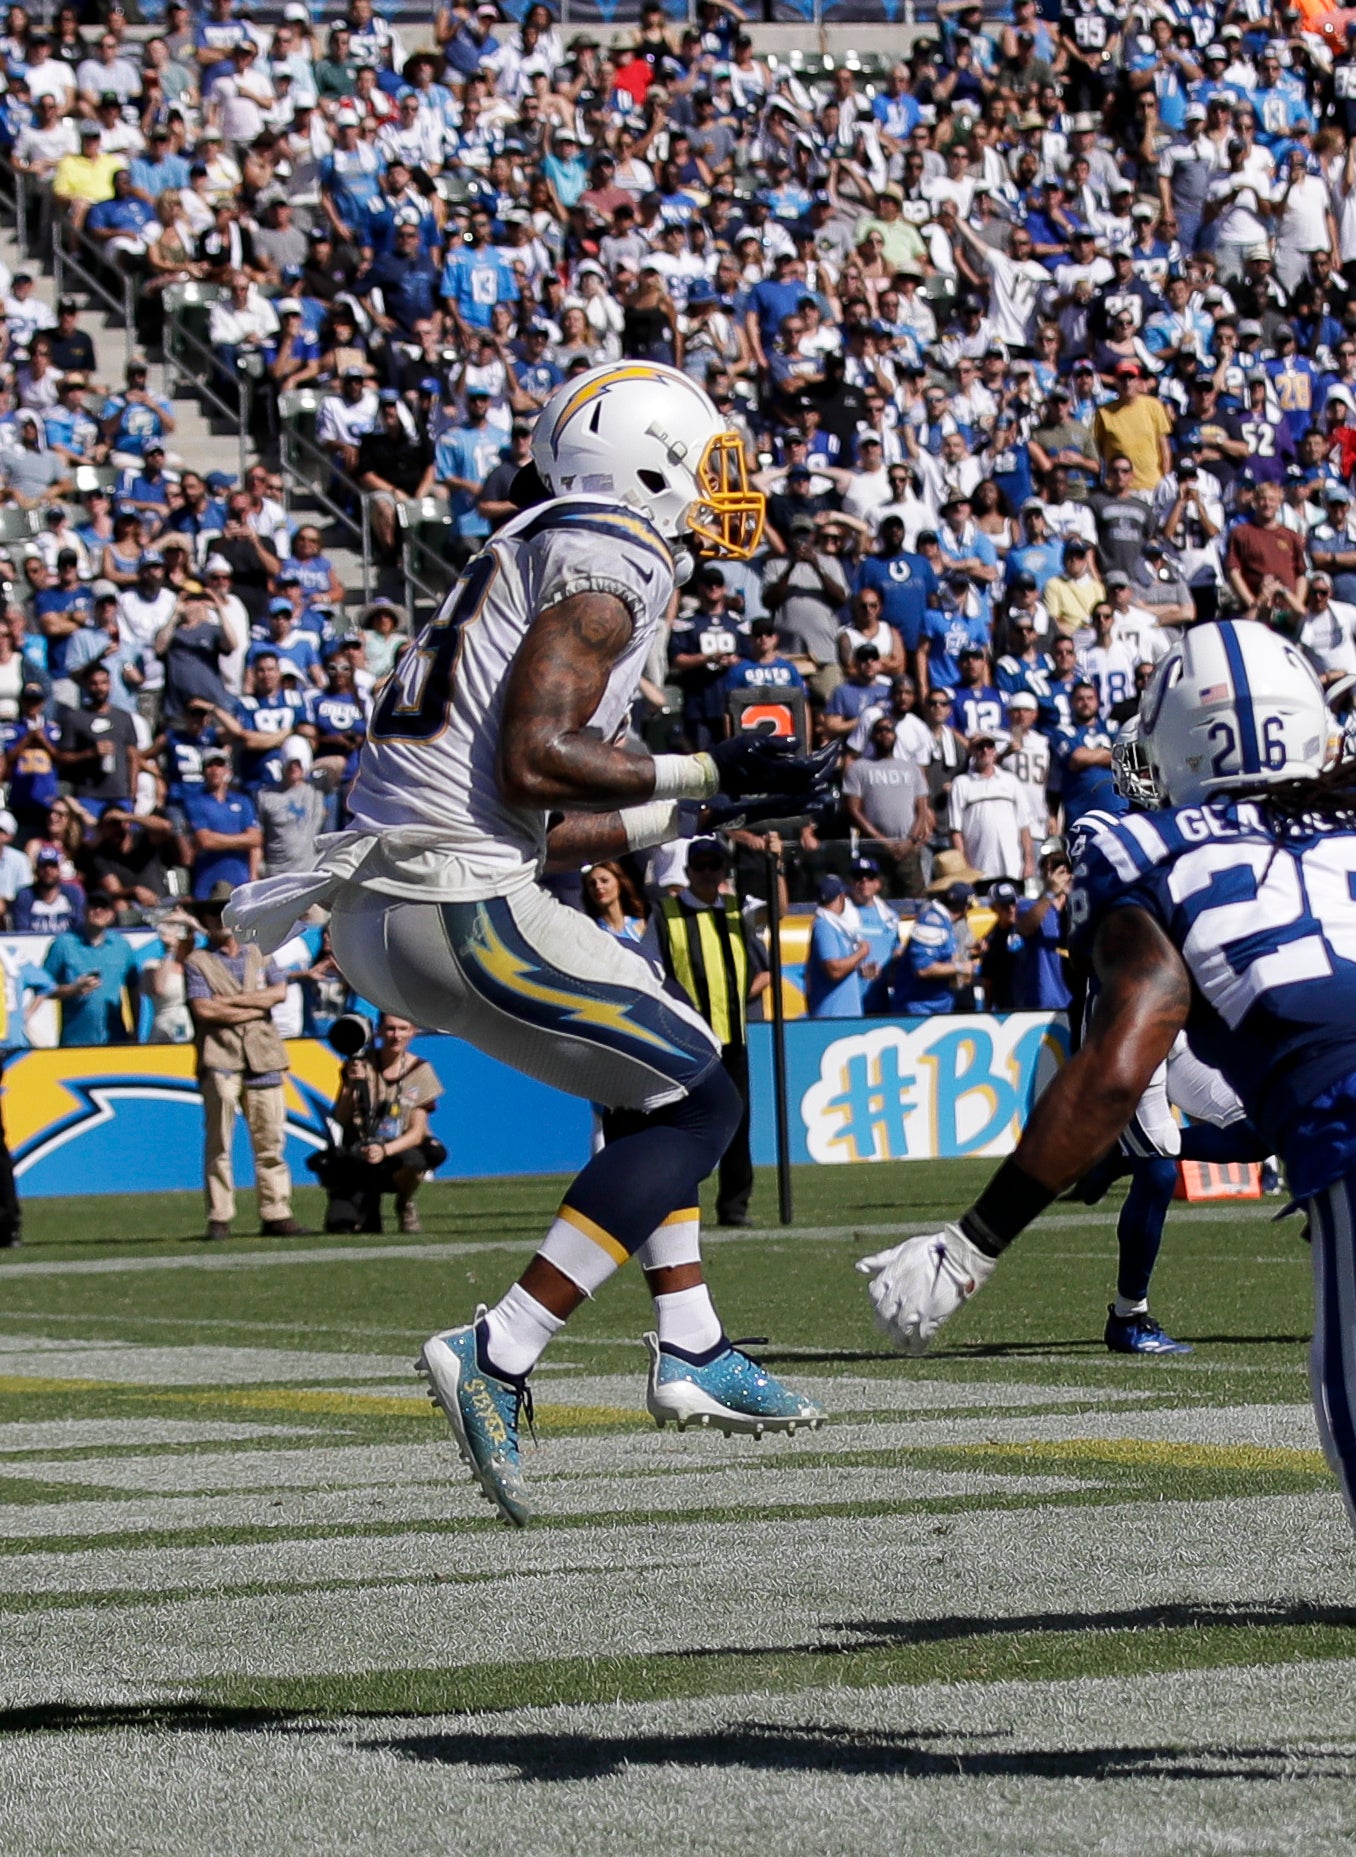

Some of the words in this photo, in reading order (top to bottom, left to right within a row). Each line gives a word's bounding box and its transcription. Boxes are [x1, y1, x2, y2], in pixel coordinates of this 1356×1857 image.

[1241, 422, 1276, 457] 52
[963, 699, 1001, 738] 12
[1207, 717, 1287, 778] 26
[867, 769, 911, 786] INDY
[1015, 753, 1044, 785] 85
